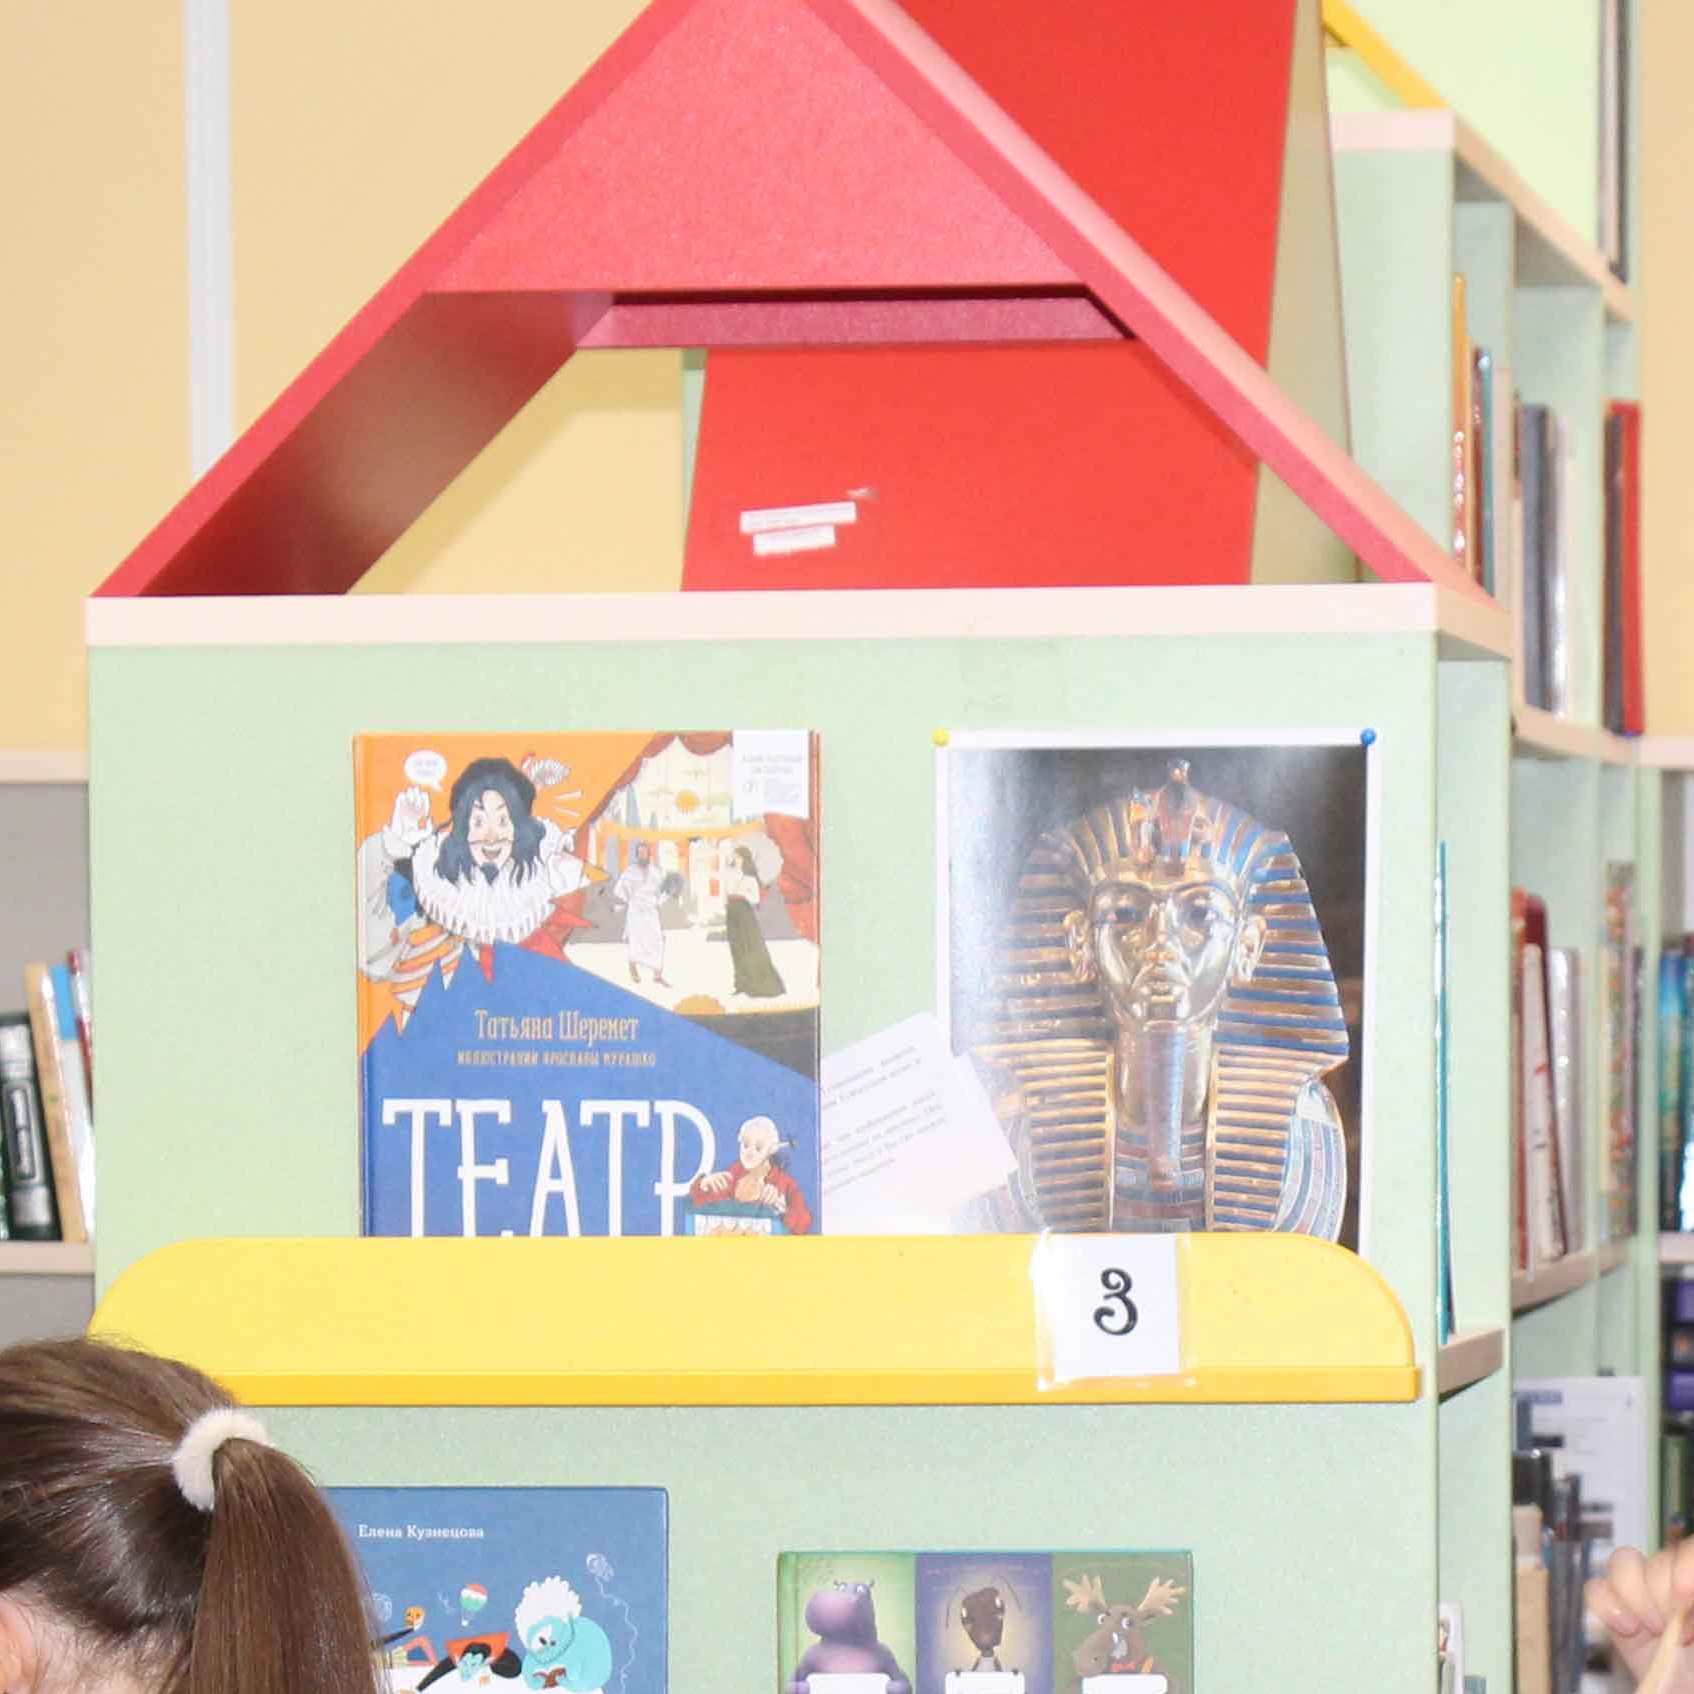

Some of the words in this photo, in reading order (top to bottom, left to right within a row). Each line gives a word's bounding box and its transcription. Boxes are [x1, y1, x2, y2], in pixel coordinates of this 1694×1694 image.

[474, 1008, 553, 1040] Татьяна
[559, 1009, 640, 1047] Шеремет
[382, 1098, 718, 1236] ТЕАТР
[1093, 1268, 1139, 1336] 3
[358, 1524, 402, 1538] Елена
[406, 1524, 485, 1541] Кузнецова
